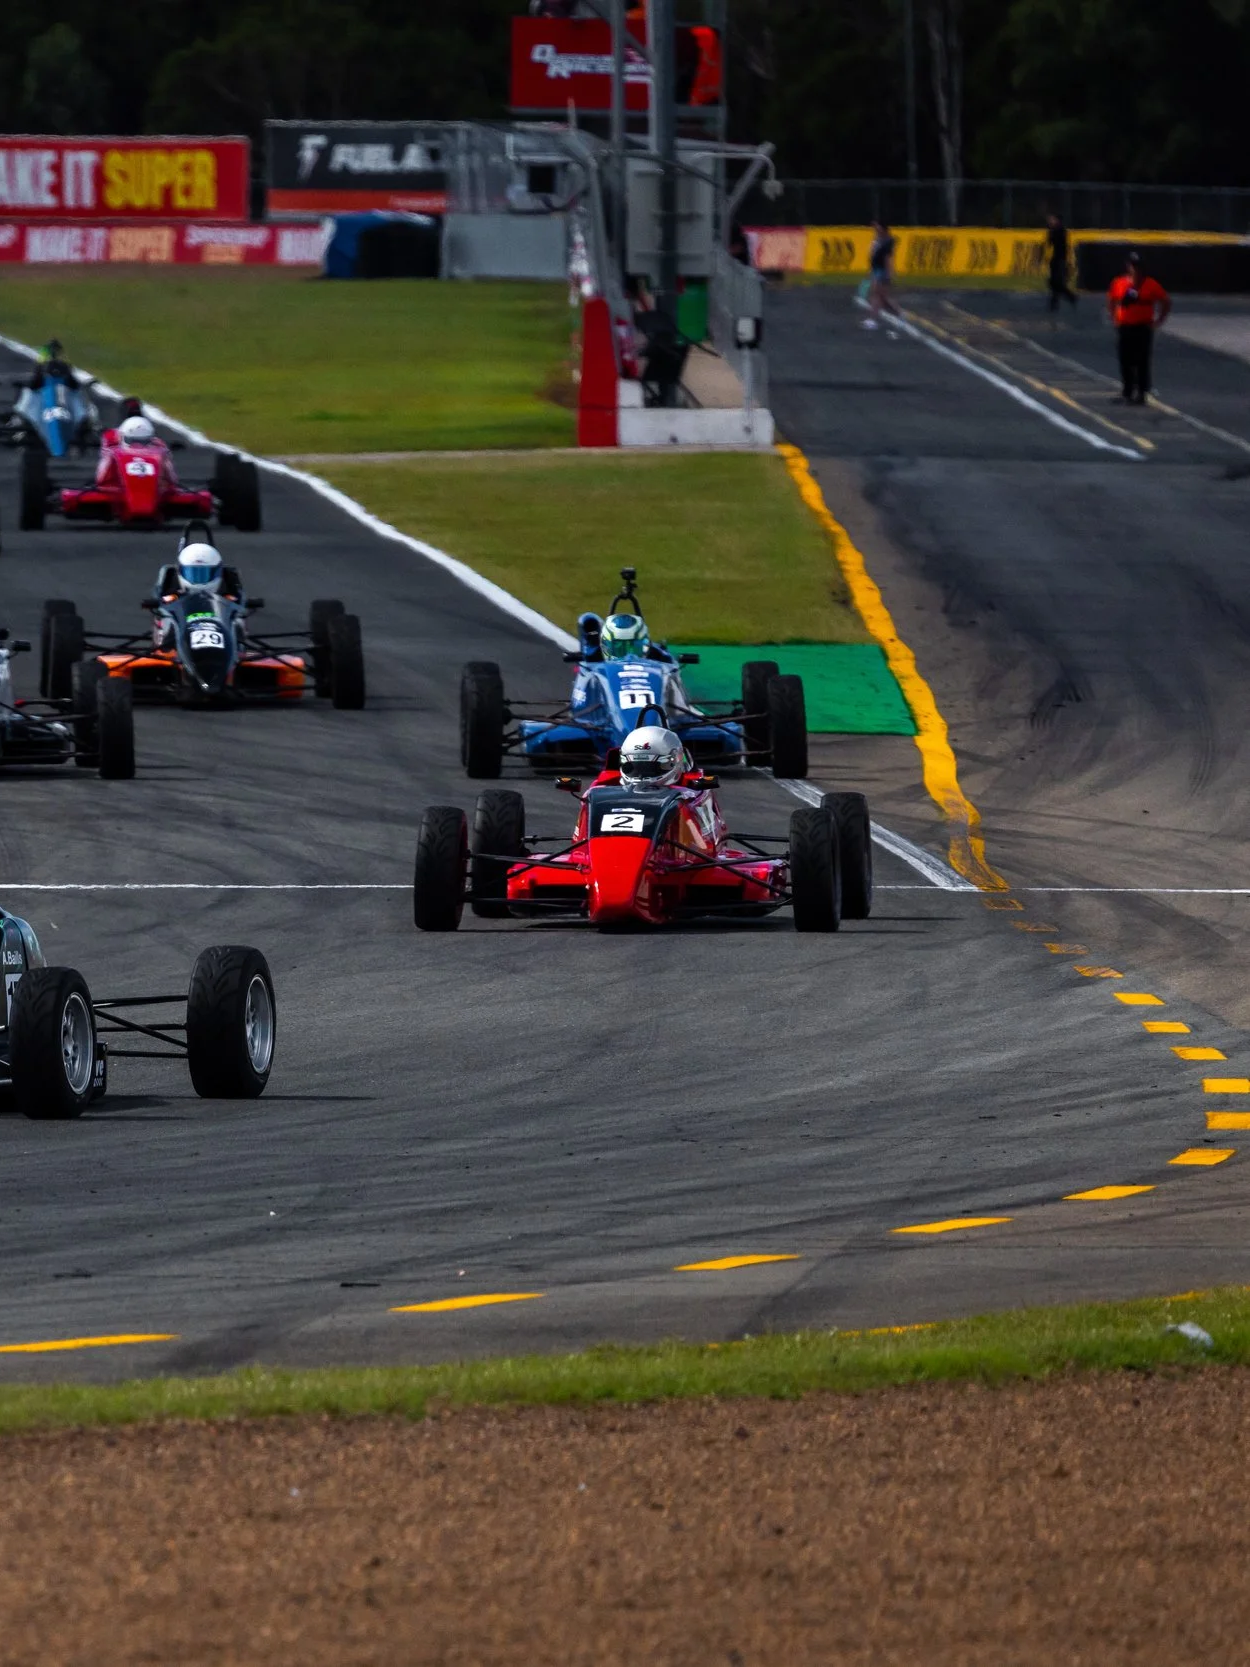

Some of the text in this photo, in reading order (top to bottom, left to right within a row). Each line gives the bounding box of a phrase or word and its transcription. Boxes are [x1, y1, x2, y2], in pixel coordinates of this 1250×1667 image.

[60, 151, 97, 208] IT
[103, 149, 216, 209] SUPER
[196, 633, 222, 645] 29
[622, 693, 652, 705] 11
[611, 815, 634, 829] 2
